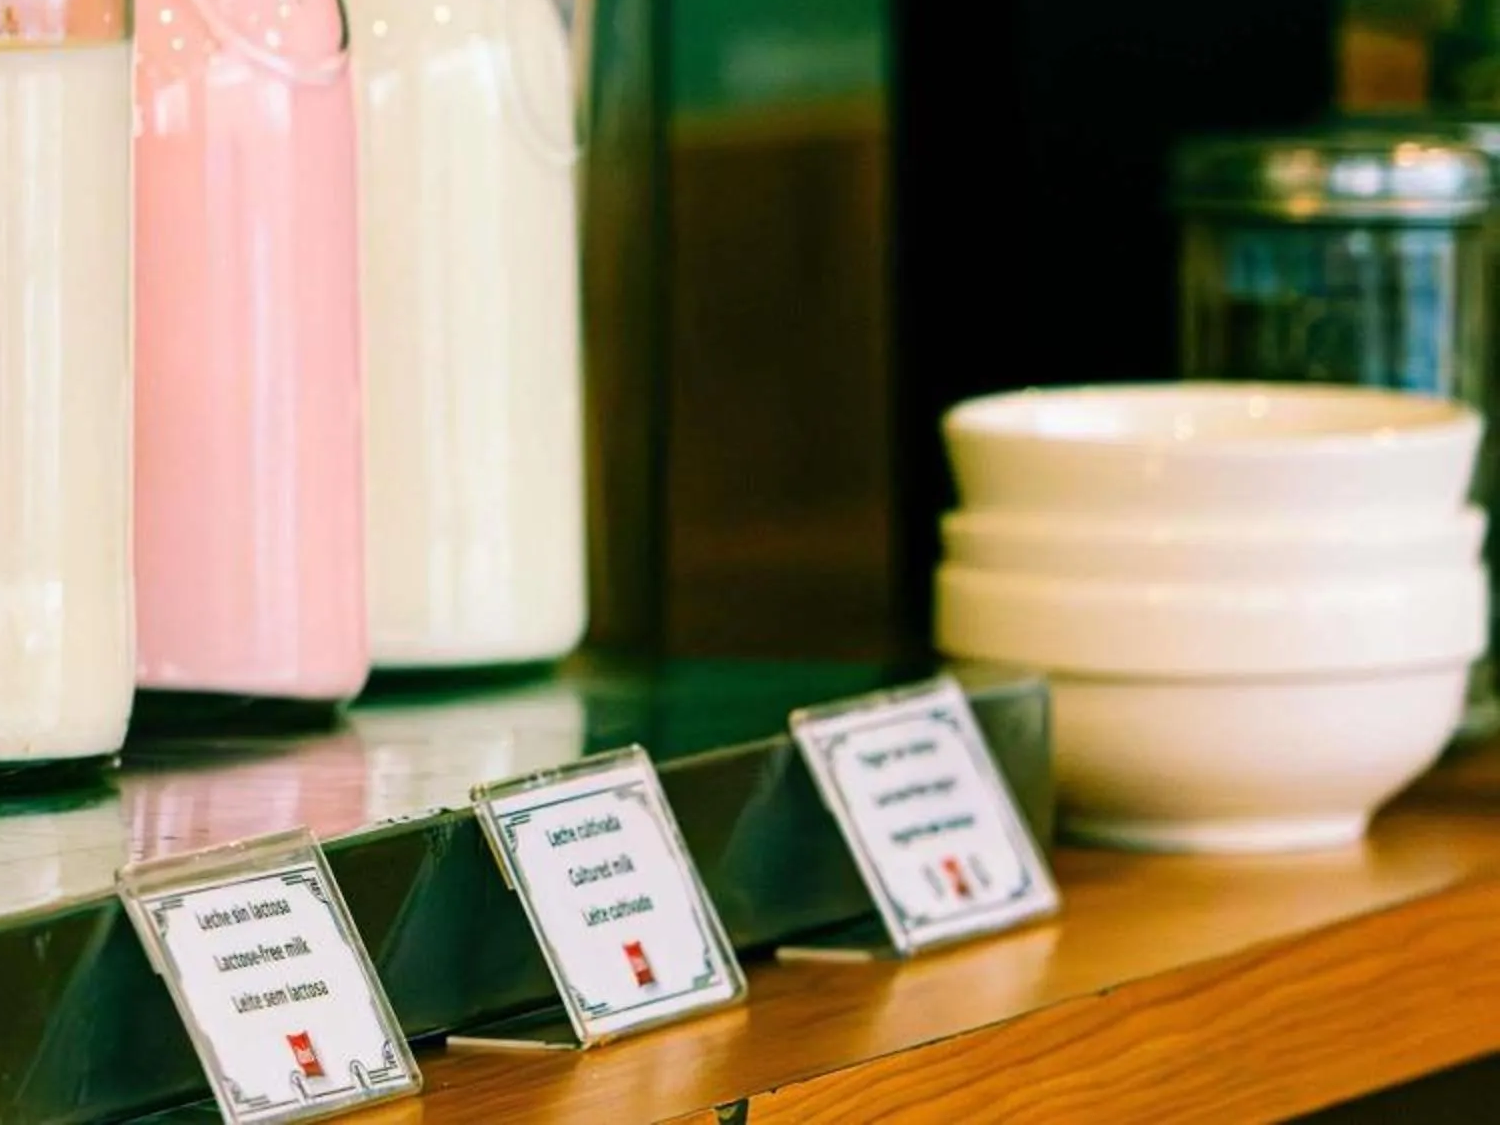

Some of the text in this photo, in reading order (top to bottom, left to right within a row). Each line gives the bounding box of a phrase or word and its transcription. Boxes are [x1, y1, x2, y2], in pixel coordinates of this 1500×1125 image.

[196, 899, 291, 931] Leche sin lactosa
[212, 935, 312, 971] Lactose-free milk
[231, 980, 329, 1014] Leite sem lactosa
